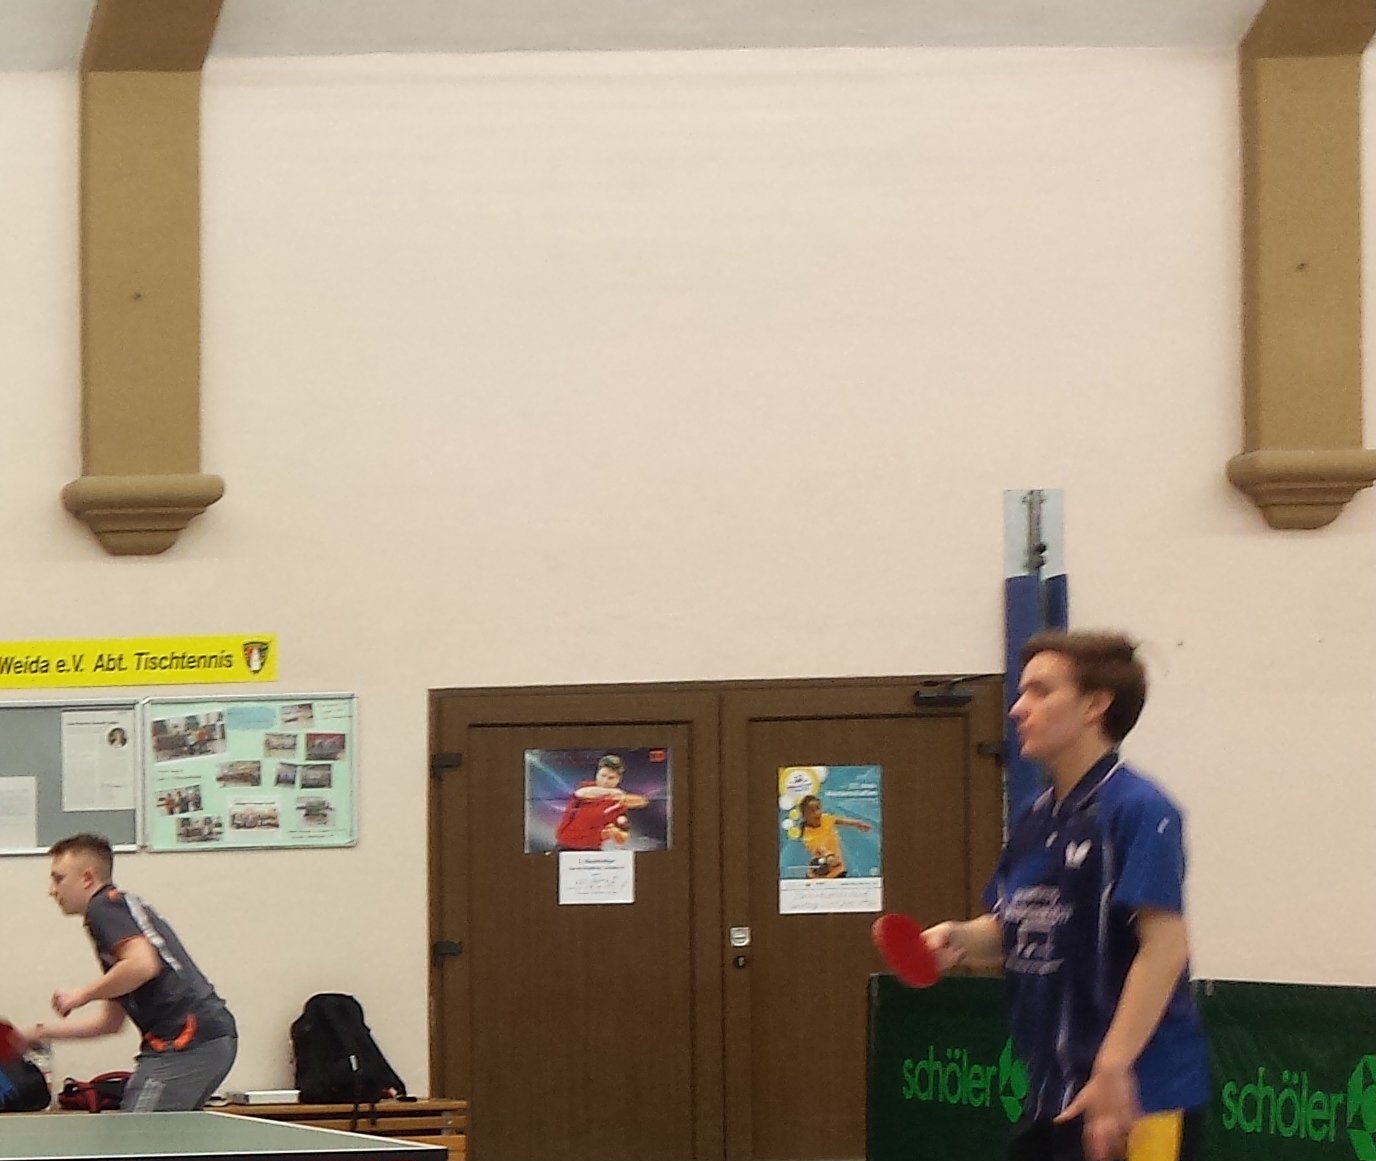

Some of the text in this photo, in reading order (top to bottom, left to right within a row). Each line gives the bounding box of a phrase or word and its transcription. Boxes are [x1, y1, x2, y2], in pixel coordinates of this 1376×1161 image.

[0, 655, 49, 675] Weida
[55, 654, 84, 674] e.V.
[93, 652, 125, 672] Abt.
[134, 649, 234, 671] Tischtennis
[902, 1045, 998, 1107] schöler
[1222, 1066, 1345, 1142] schöler
